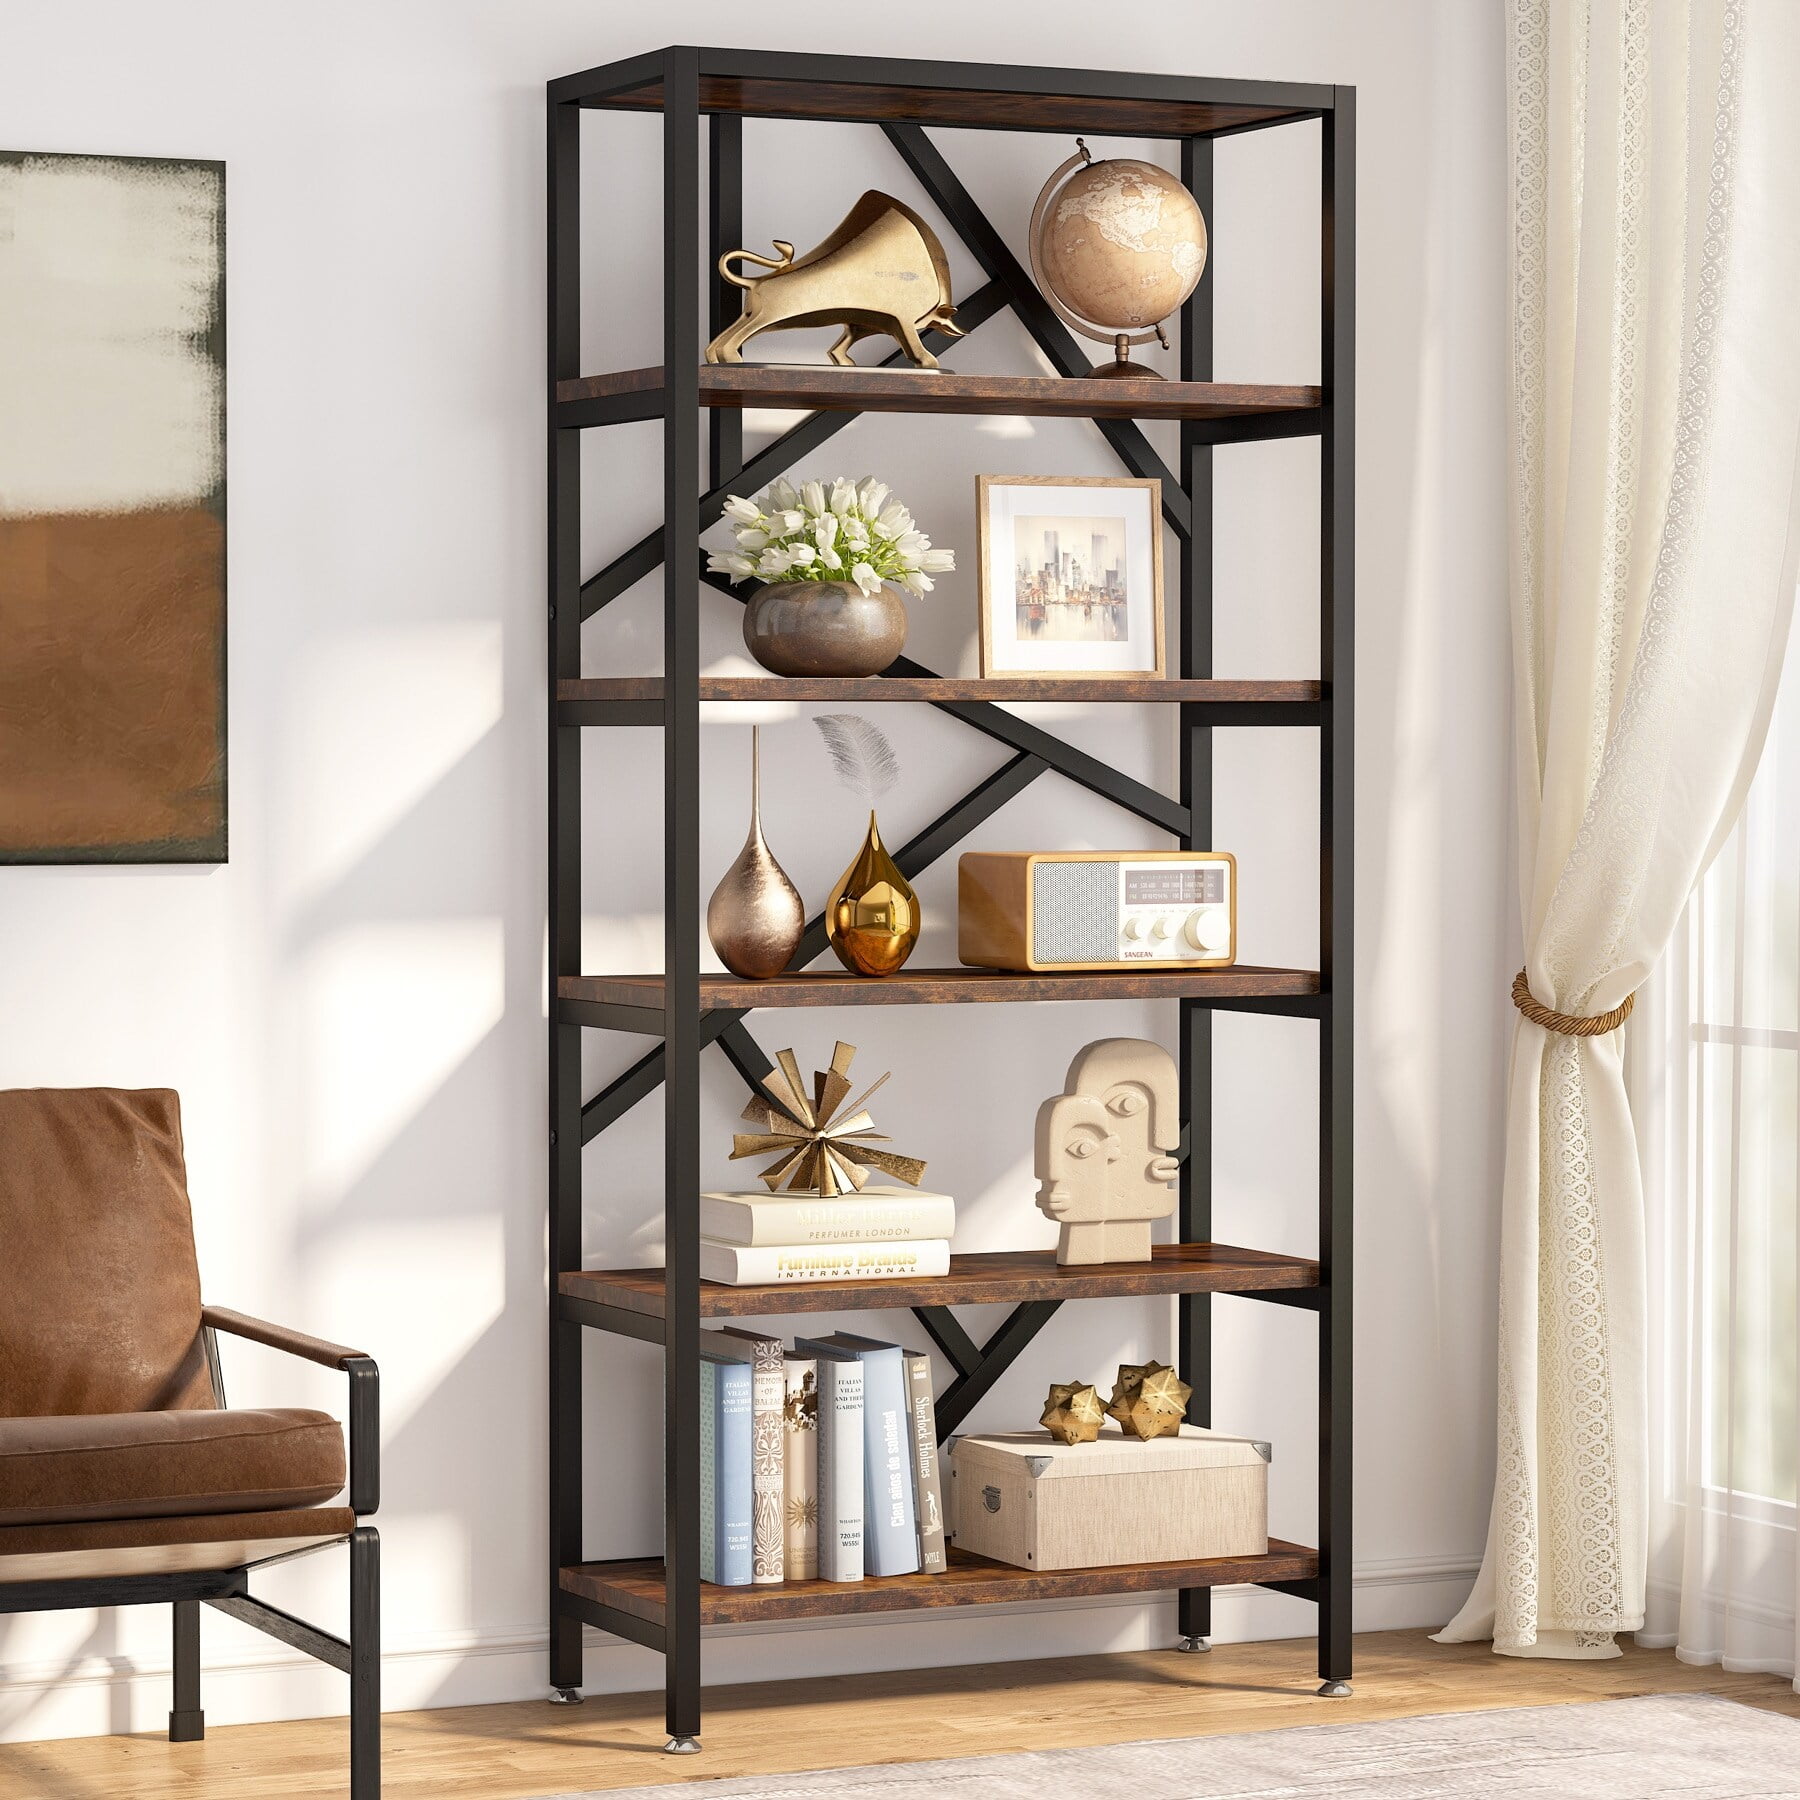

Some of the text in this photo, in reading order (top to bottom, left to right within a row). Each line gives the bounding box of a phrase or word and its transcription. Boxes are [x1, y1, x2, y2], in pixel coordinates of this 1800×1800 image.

[809, 1228, 910, 1239] PERFUMER LONDON
[777, 1249, 918, 1271] Furniture Brands
[777, 1266, 916, 1279] INTERNATIONAL
[916, 1396, 932, 1440] Sherlock
[882, 1410, 905, 1527] Cien años de soledad
[919, 1442, 934, 1479] Holmes
